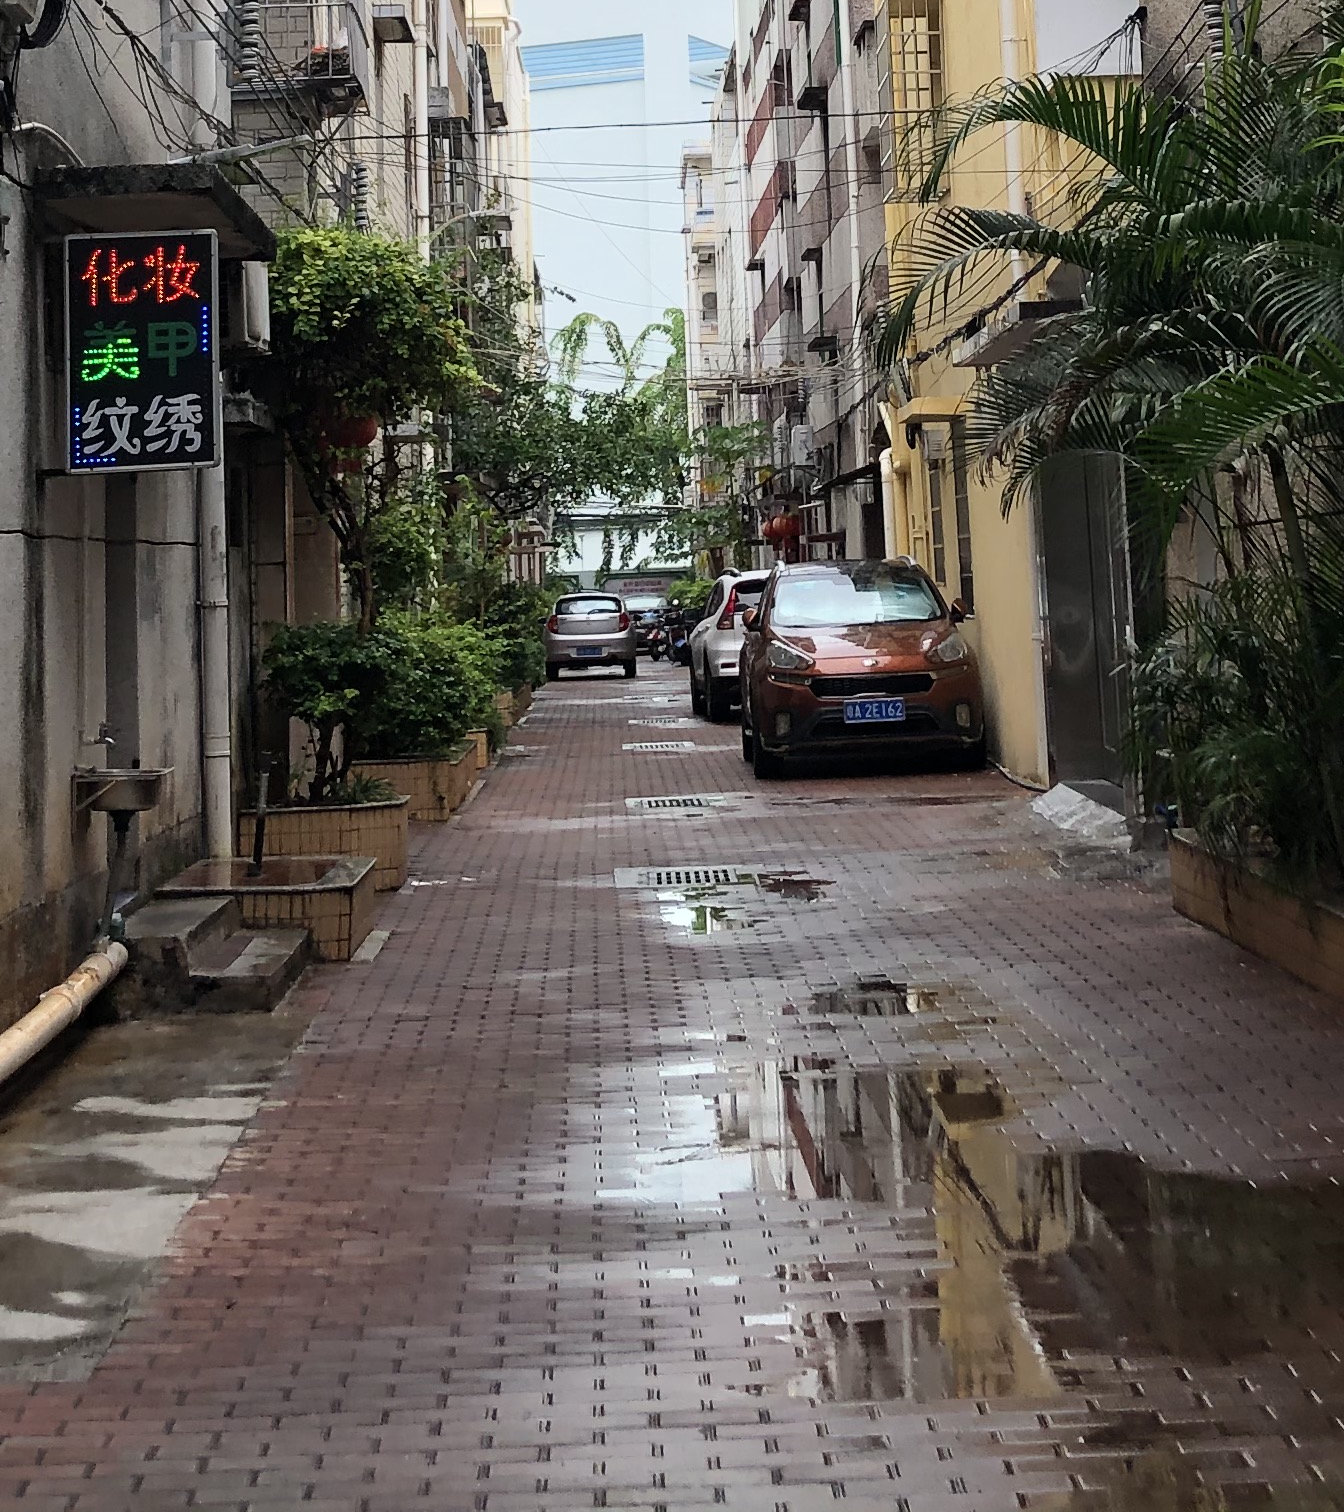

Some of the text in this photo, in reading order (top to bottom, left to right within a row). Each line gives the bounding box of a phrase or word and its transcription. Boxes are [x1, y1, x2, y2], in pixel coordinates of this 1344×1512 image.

[81, 244, 201, 307] 化妆
[81, 320, 197, 382] 美甲
[82, 393, 204, 457] 纹绣
